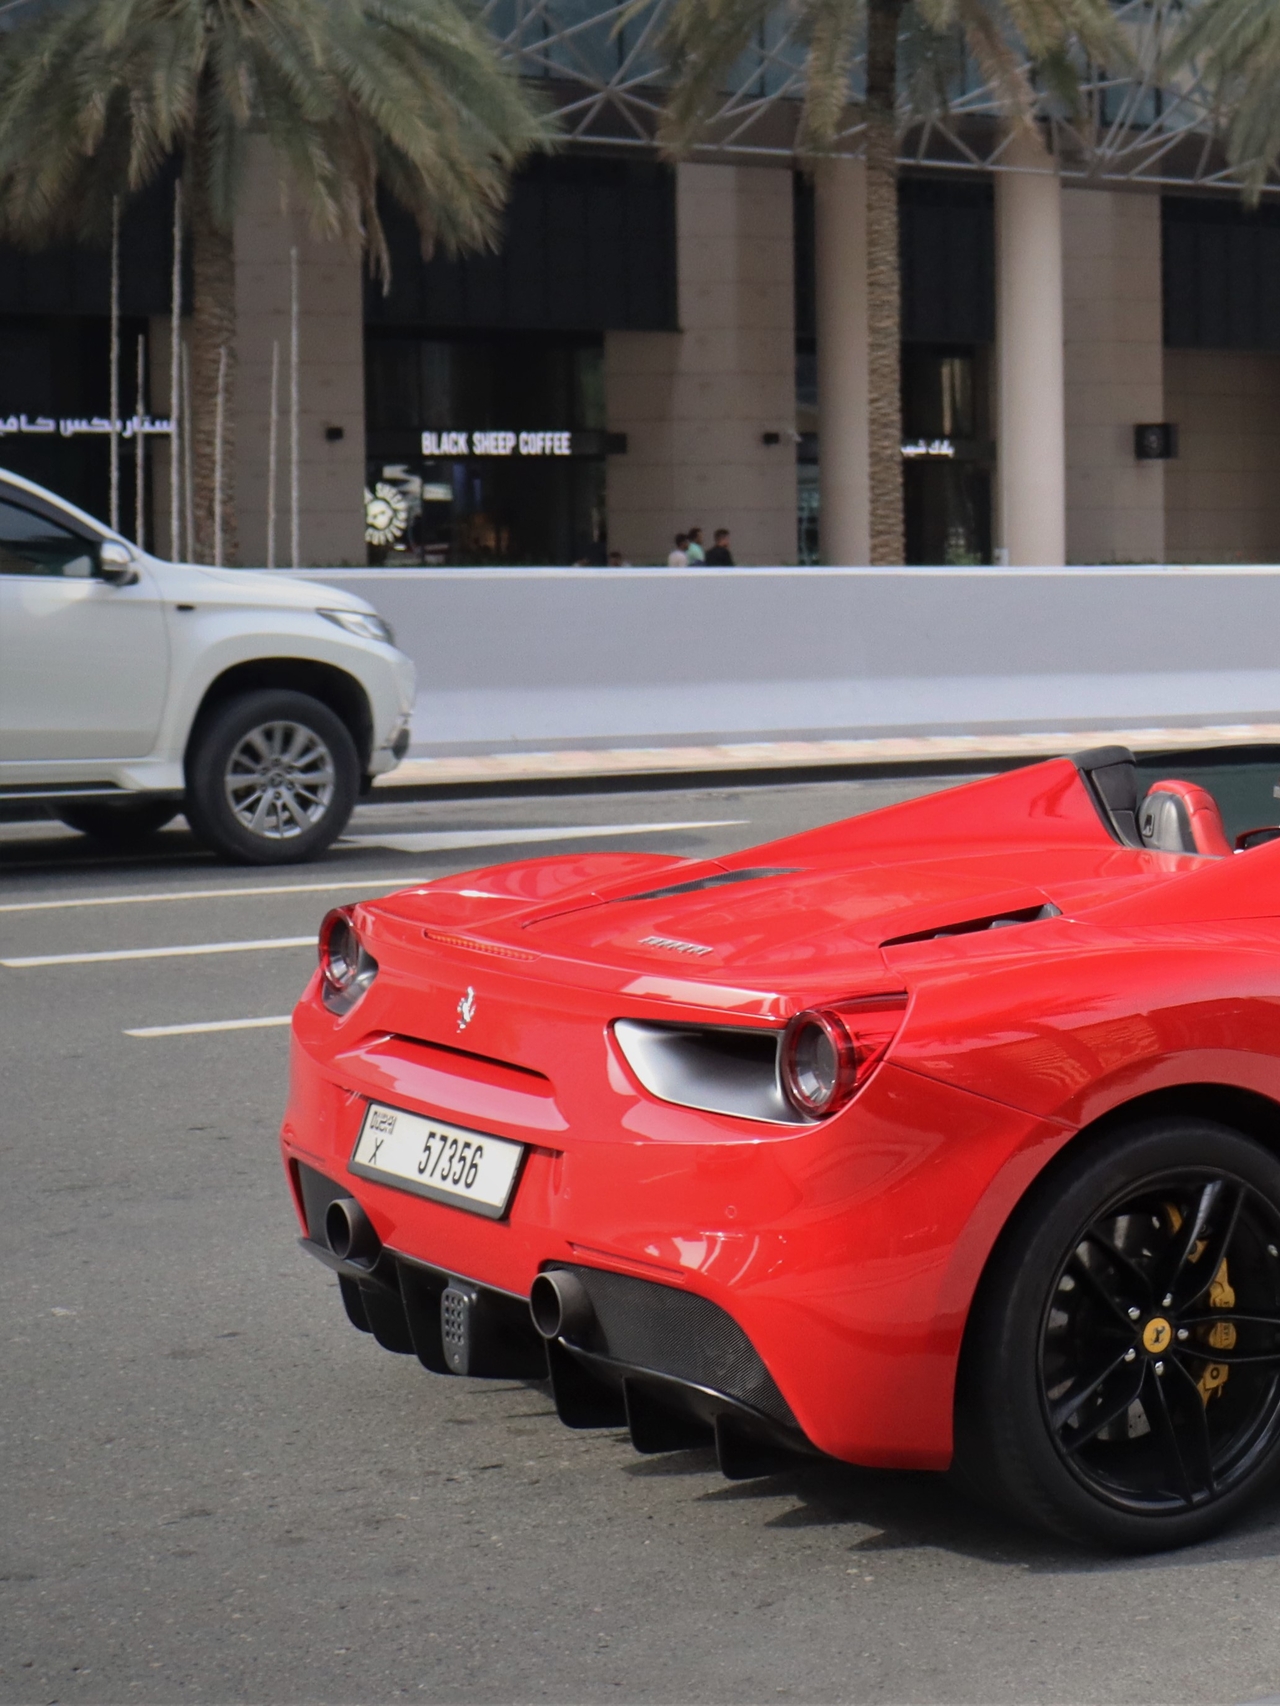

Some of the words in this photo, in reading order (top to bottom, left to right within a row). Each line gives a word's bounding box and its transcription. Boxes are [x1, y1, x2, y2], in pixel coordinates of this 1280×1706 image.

[421, 431, 469, 455] BLACK
[472, 431, 517, 455] SHEEP
[519, 431, 571, 455] COFFEE
[368, 1137, 384, 1165] X
[417, 1131, 483, 1189] 57356
